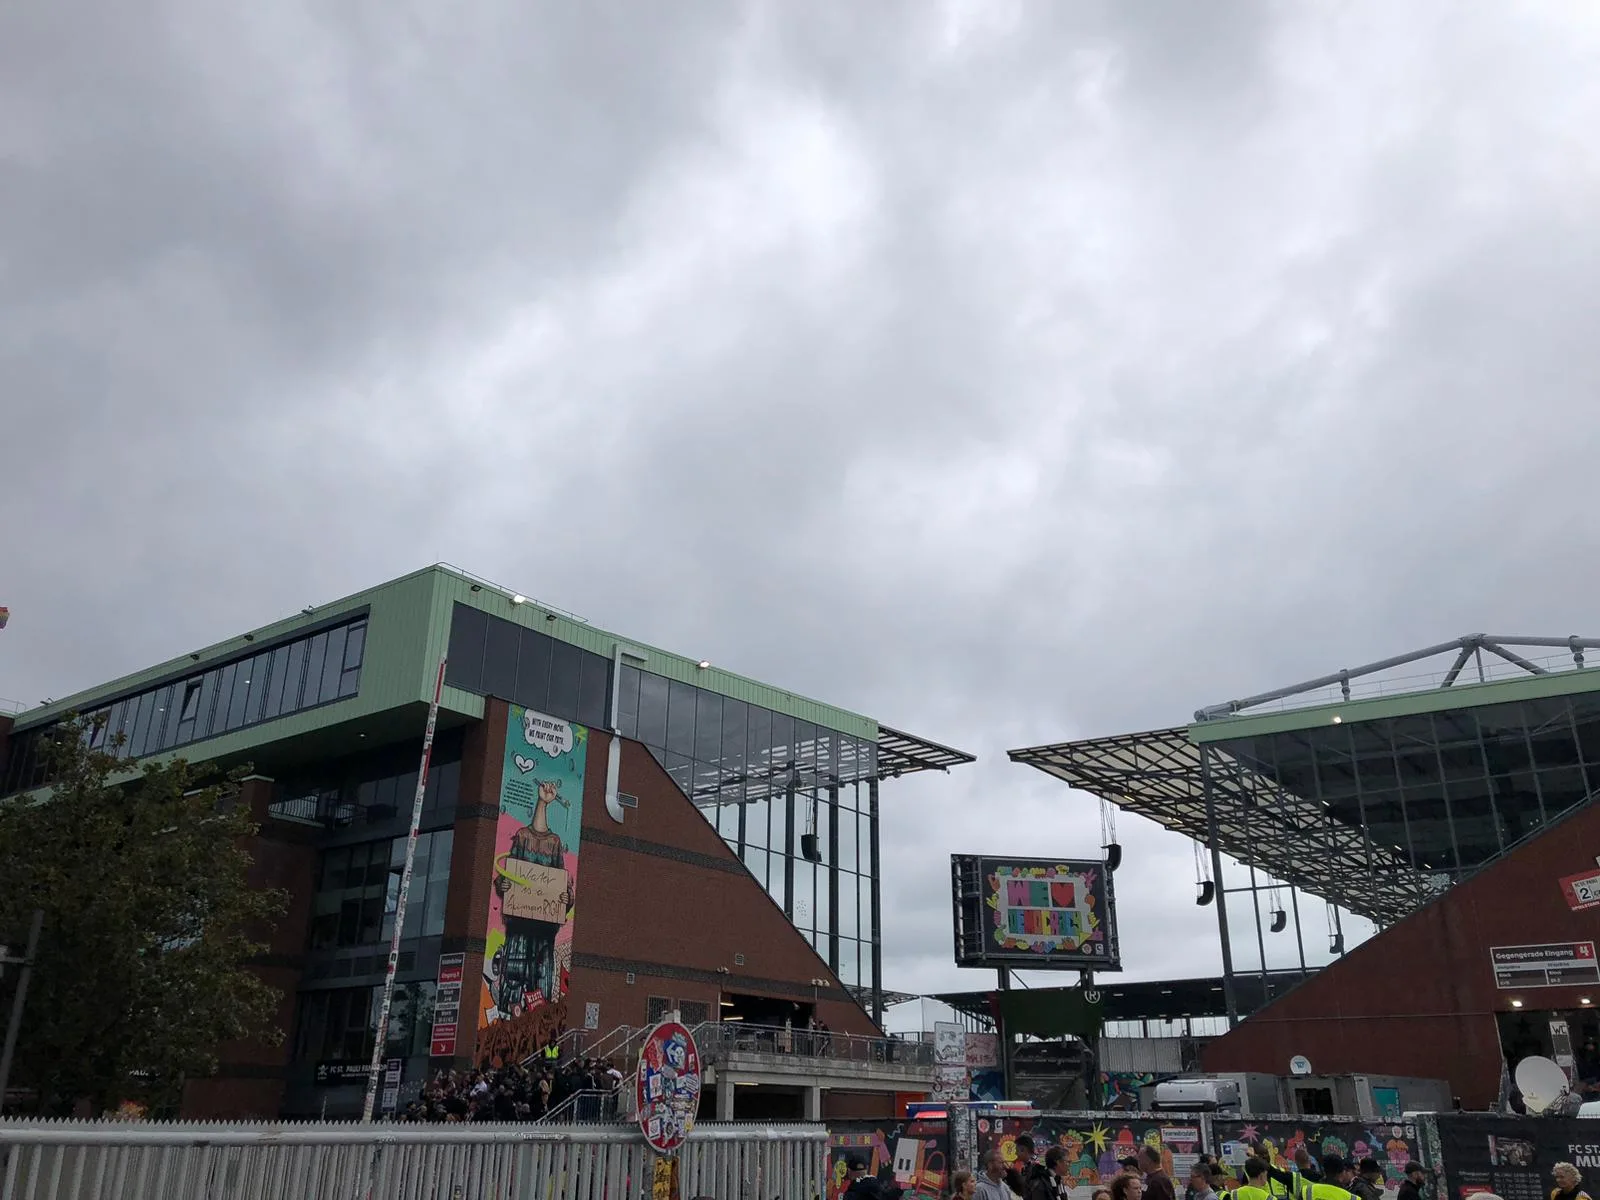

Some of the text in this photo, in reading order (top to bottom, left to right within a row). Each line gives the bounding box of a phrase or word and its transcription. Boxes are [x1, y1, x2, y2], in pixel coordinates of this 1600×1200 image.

[1580, 888, 1591, 899] 2
[1008, 909, 1083, 936] DEMOCRACY
[1496, 946, 1589, 960] Gegengerade Eingang 4
[1552, 1024, 1567, 1034] WC
[1568, 1144, 1583, 1154] FC
